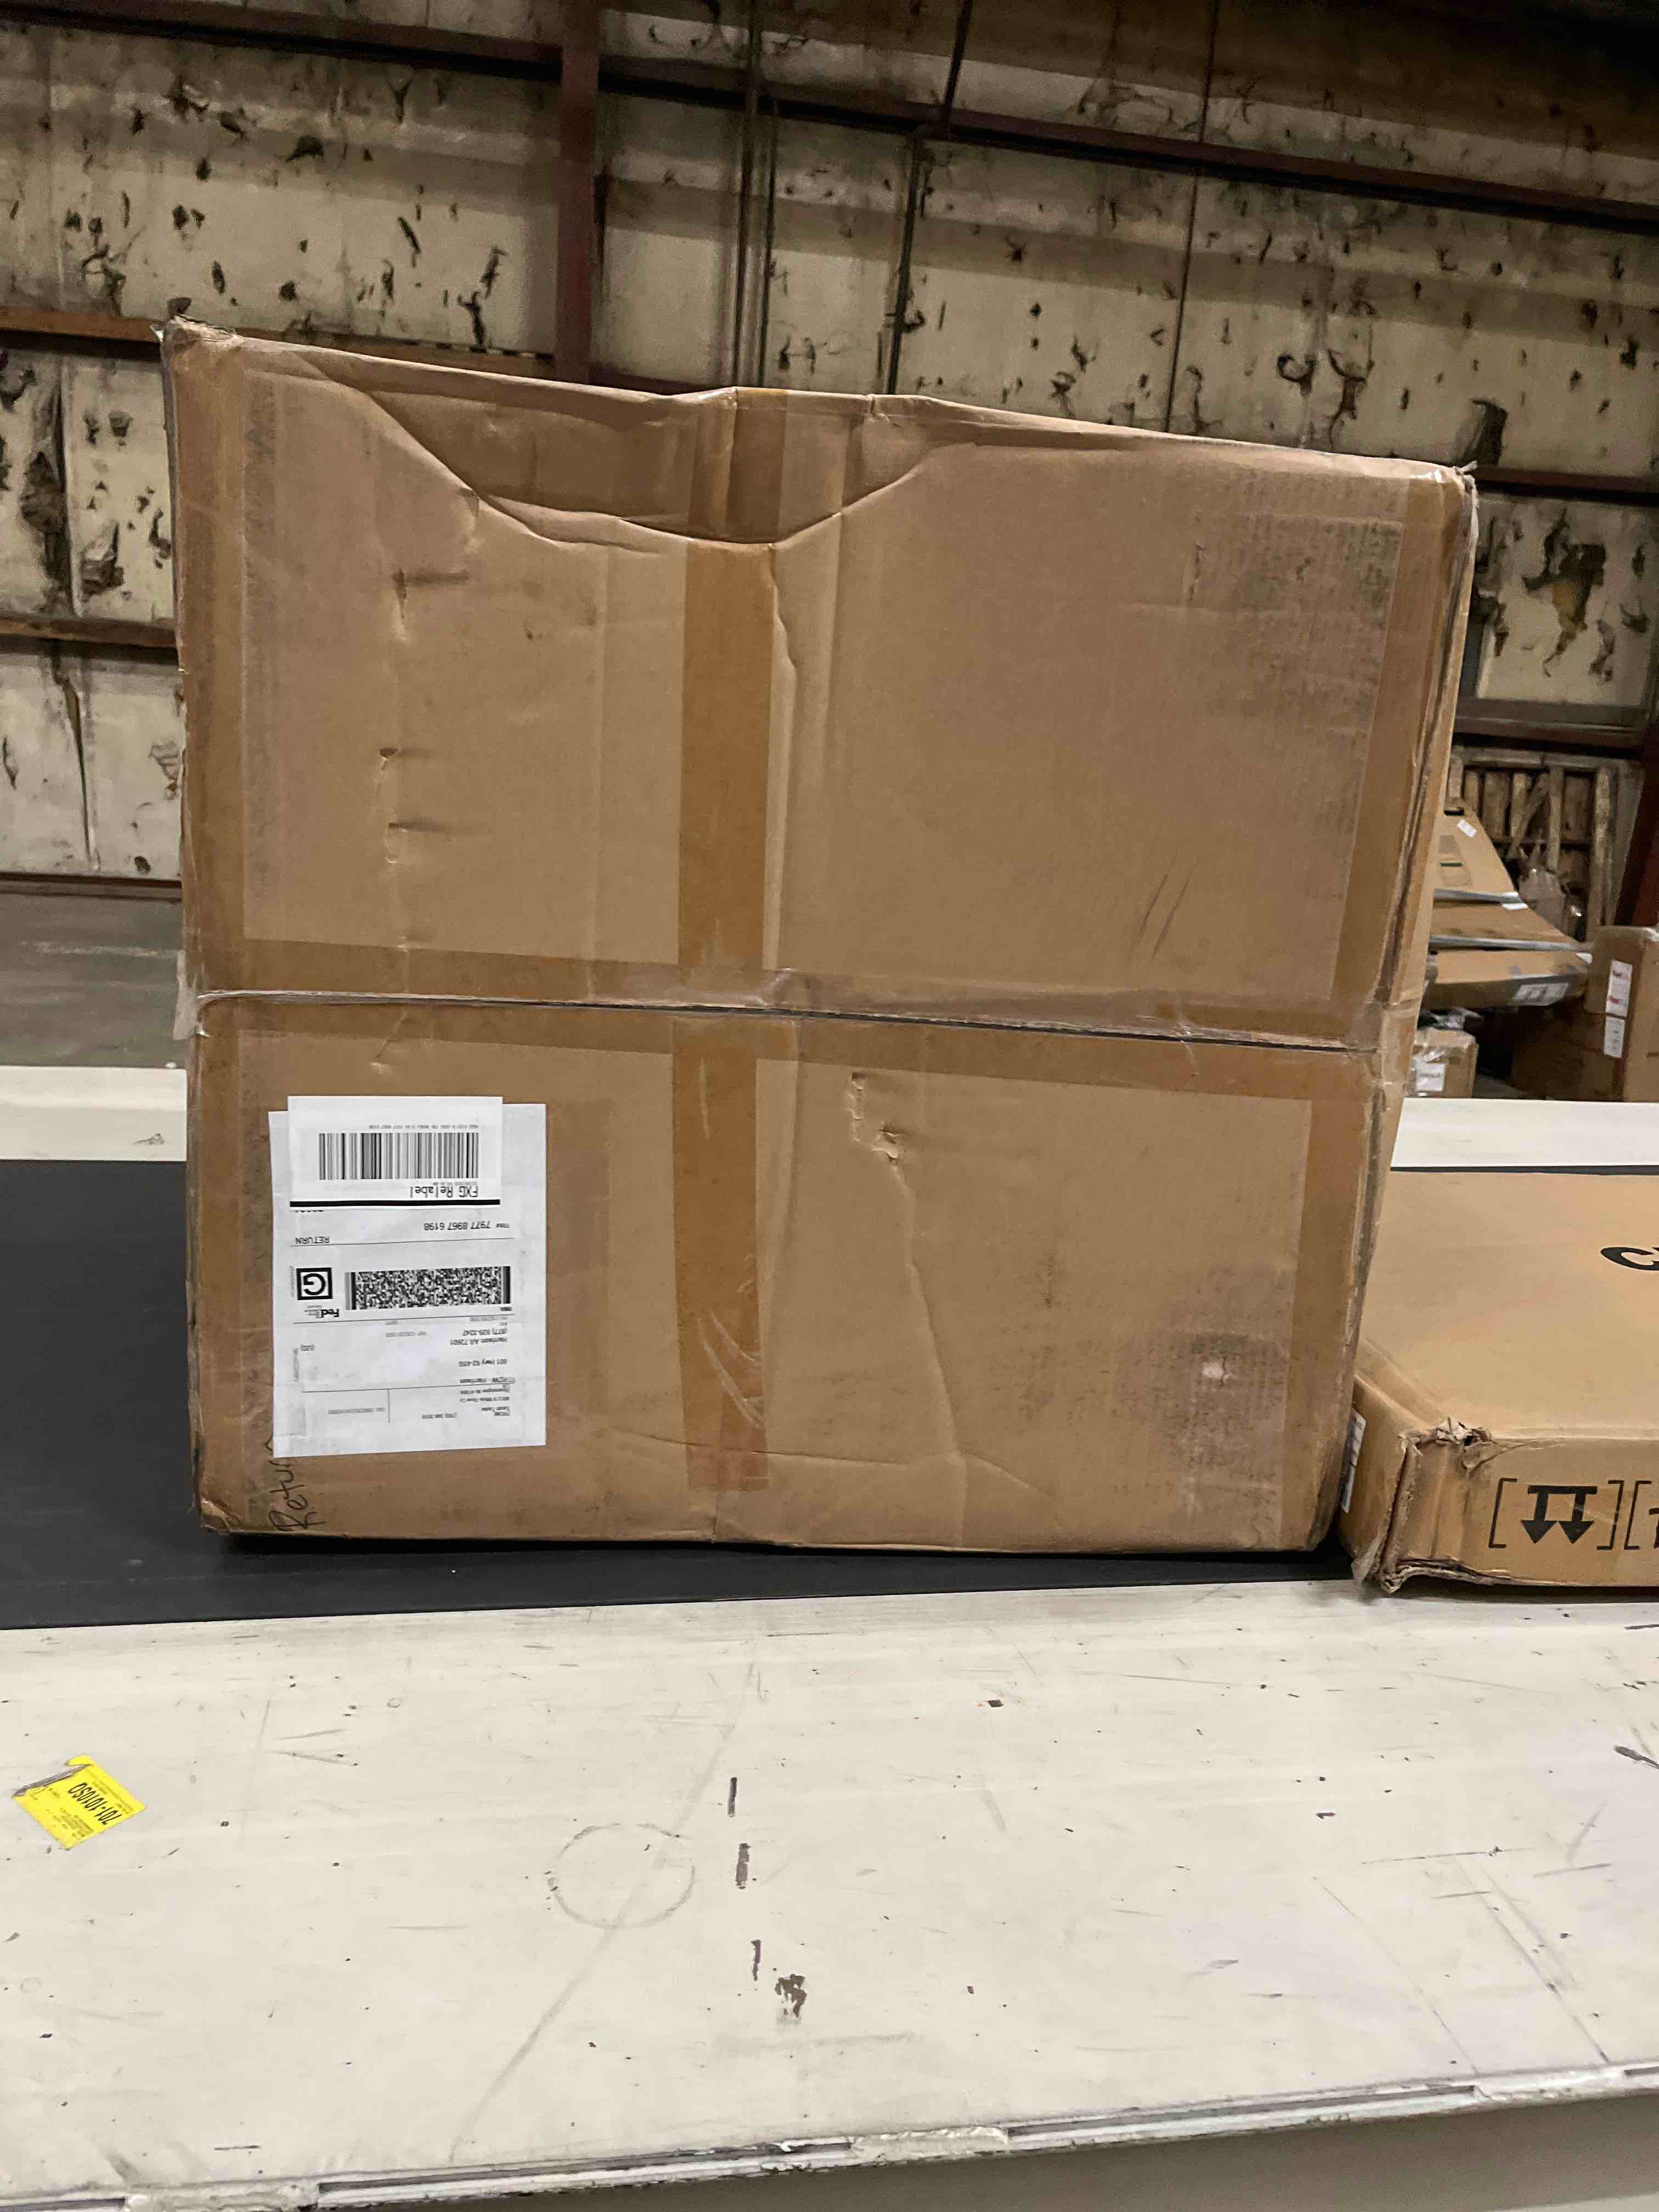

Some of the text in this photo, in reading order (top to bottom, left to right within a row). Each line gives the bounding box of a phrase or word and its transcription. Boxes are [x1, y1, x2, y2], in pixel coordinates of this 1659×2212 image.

[410, 1186, 479, 1198] FXG Relabel
[424, 1222, 445, 1231] 6198
[448, 1221, 469, 1230] 8967
[470, 1220, 492, 1229] 7977
[295, 1237, 330, 1245] RETURN
[302, 1273, 326, 1295] G
[263, 1436, 326, 1531] Retur
